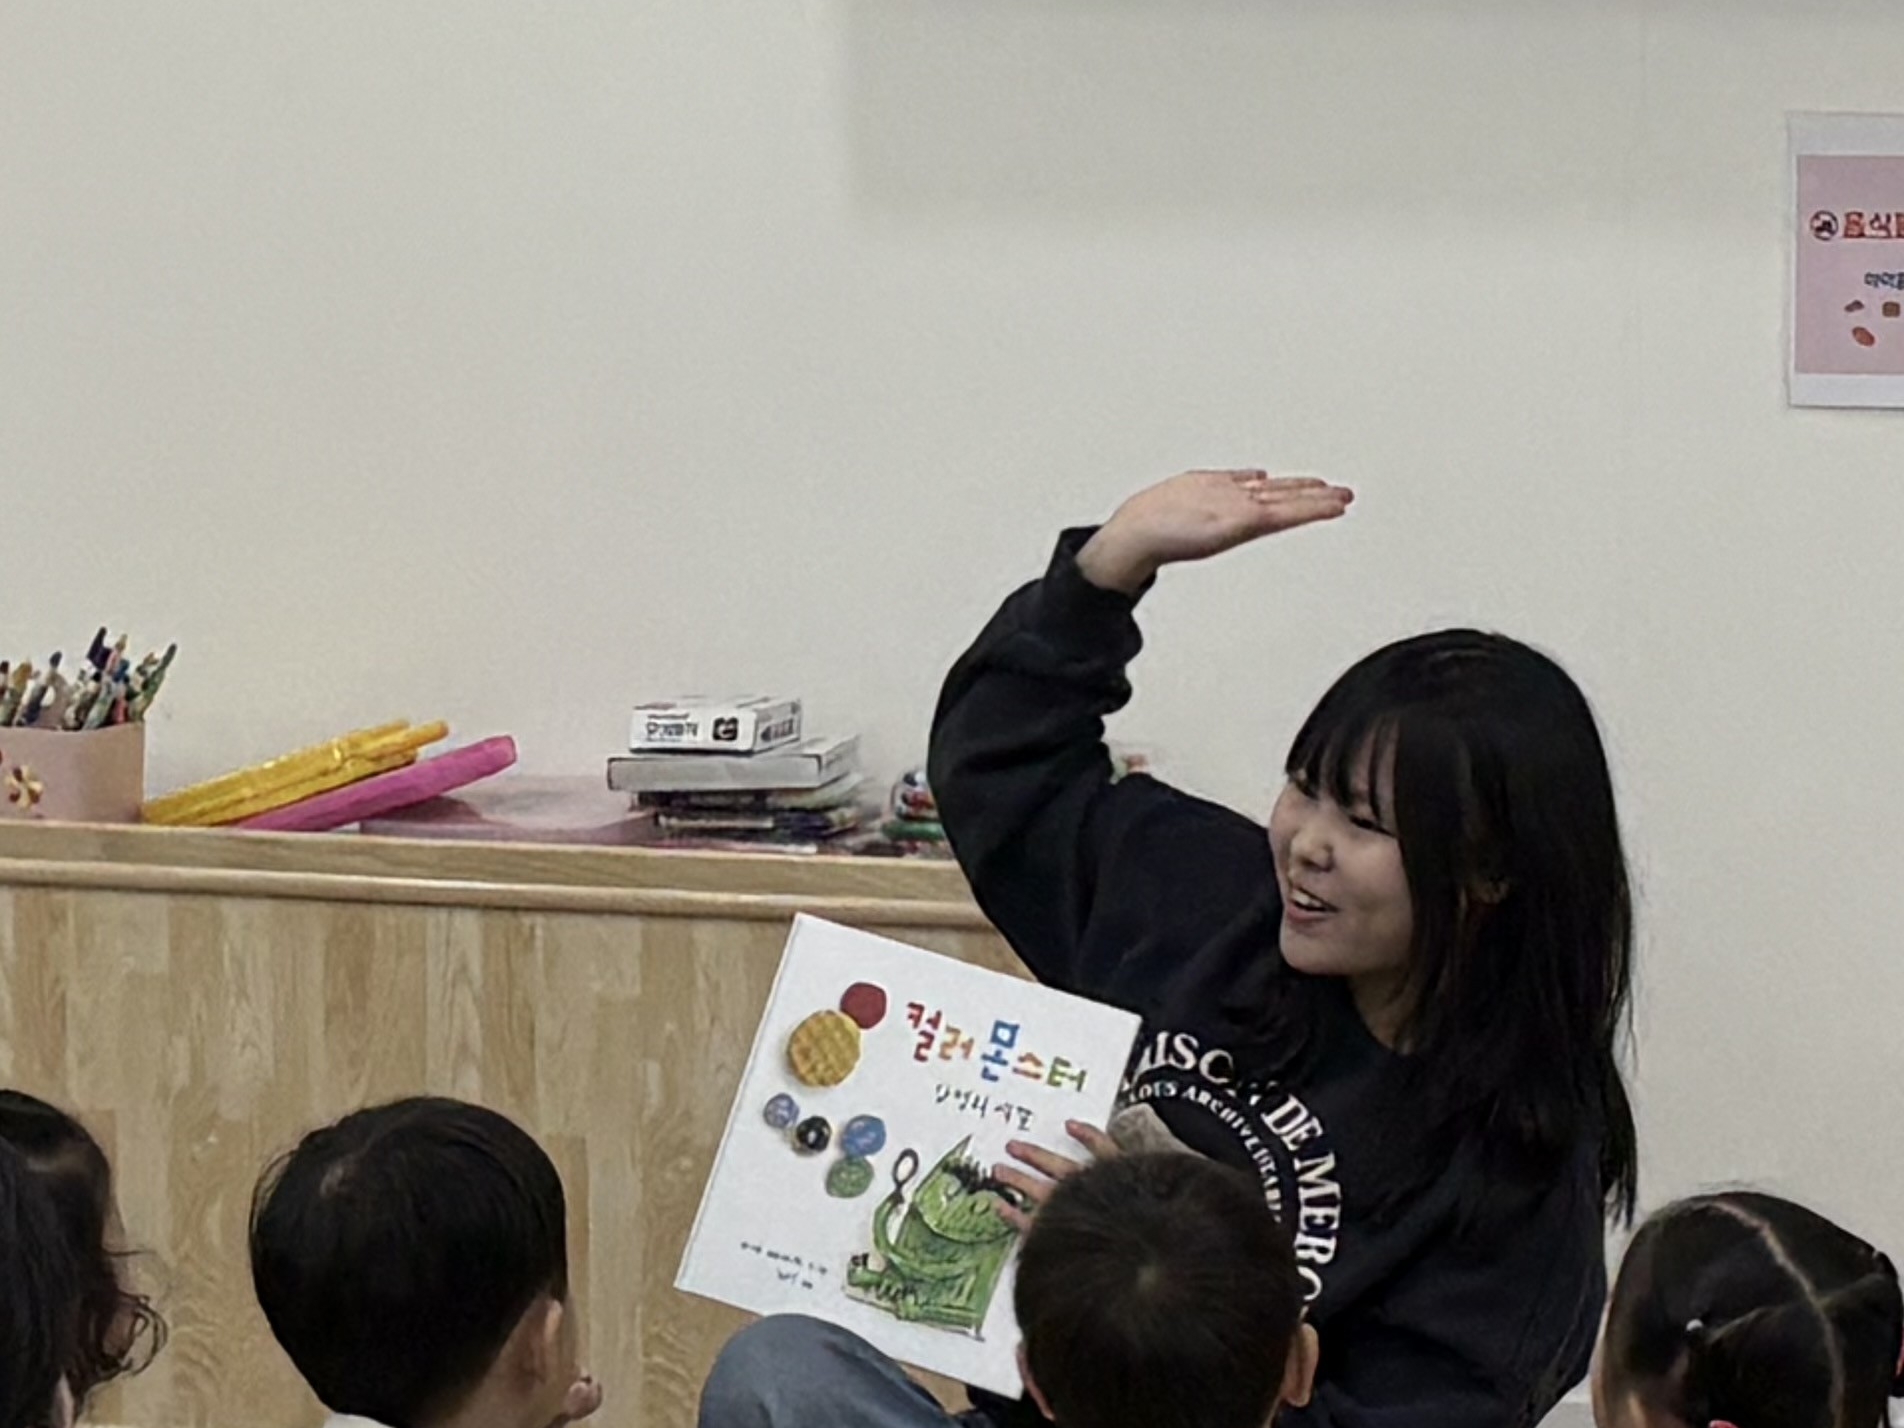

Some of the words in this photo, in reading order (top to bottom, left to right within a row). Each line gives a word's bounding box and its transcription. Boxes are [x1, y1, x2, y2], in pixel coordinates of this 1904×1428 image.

[904, 1002, 976, 1062] 컬러
[979, 1019, 1088, 1093] 몬스터
[1261, 1093, 1324, 1152] DE
